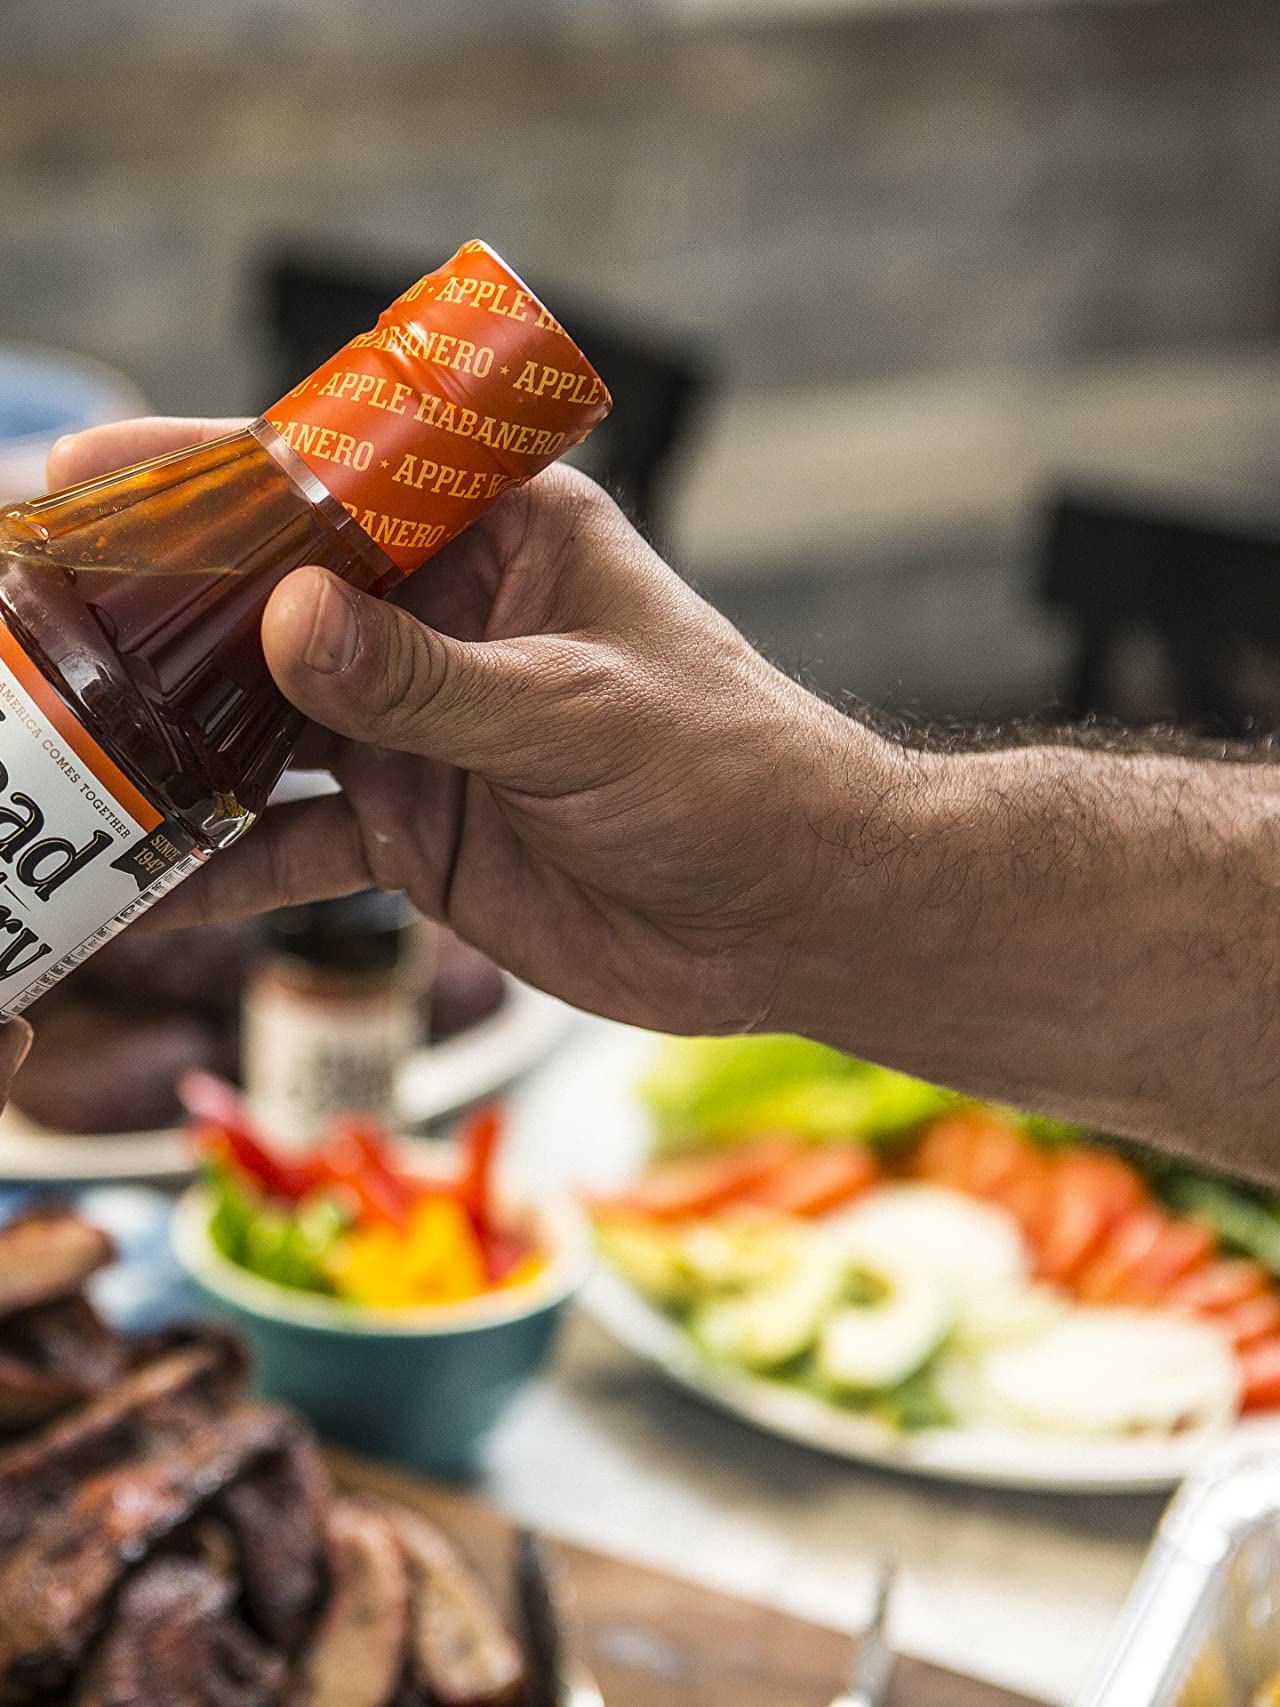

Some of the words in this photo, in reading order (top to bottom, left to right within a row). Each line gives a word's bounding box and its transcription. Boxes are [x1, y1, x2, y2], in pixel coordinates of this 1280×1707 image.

[435, 276, 533, 322] APPLE
[513, 361, 602, 405] APPLE
[318, 372, 413, 415] APPLE
[414, 394, 566, 456] HABANERO
[392, 453, 487, 499] APPLE
[42, 739, 81, 784] COMES
[79, 783, 132, 839] TOGETHER
[133, 847, 166, 874] 1947
[151, 834, 182, 862] SINCE
